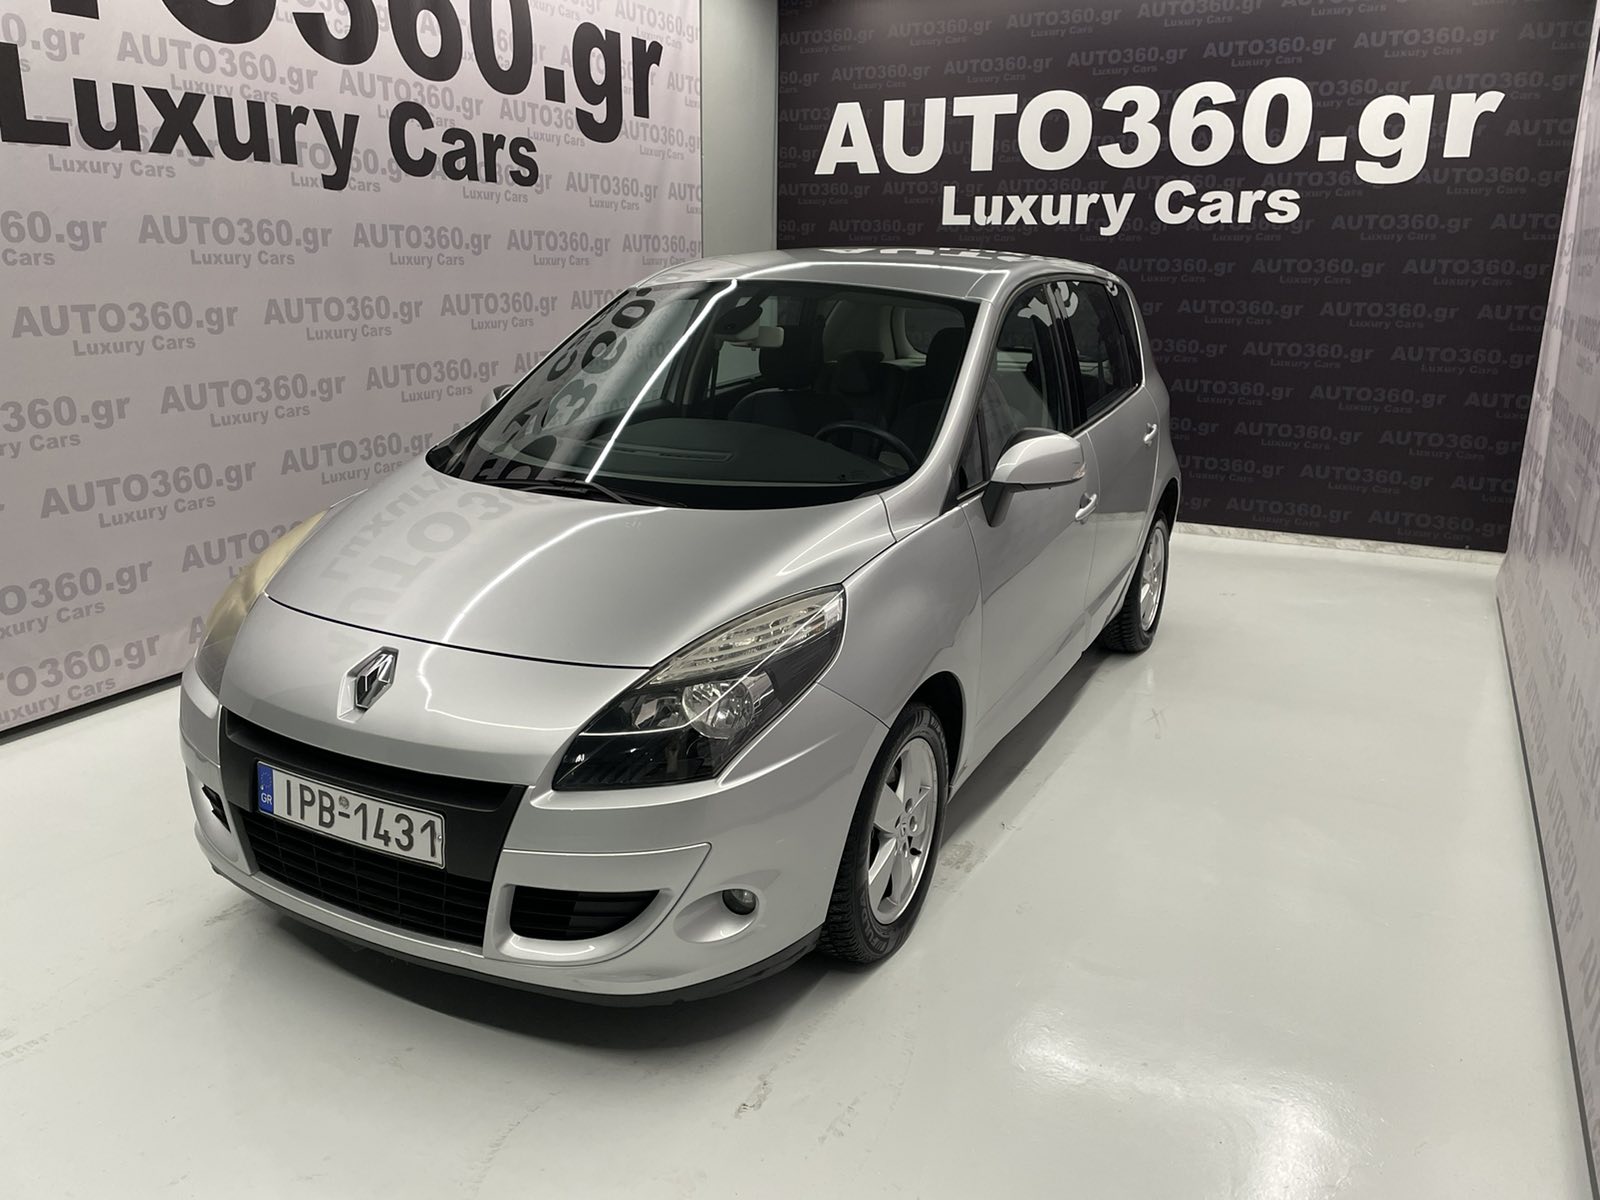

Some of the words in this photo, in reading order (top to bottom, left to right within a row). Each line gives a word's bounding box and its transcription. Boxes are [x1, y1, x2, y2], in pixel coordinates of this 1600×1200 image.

[886, 18, 993, 39] AUTO360.gr
[1005, 7, 1122, 29] AUTO360.gr
[1202, 36, 1337, 58] AUTO360.gr
[1352, 25, 1501, 49] AUTO360.gr
[116, 31, 320, 98] AUTO360.gr
[943, 55, 1053, 75] AUTO360.gr
[1066, 46, 1188, 67] AUTO360.gr
[50, 0, 663, 143] 60.gr
[830, 63, 931, 82] AUTO360.gr
[1427, 70, 1584, 93] AUTO360.gr
[171, 75, 236, 104] Luxury
[241, 86, 281, 107] Cars
[339, 69, 485, 121] AUTO360.gr
[0, 41, 360, 190] Luxury
[388, 101, 539, 187] Cars
[526, 127, 561, 147] Luxury
[563, 132, 586, 147] Cars
[814, 77, 1506, 185] AUTO360.gr
[638, 143, 666, 161] Luxury
[667, 148, 685, 161] Cars
[48, 151, 122, 179] Luxury
[129, 158, 176, 178] Cars
[1414, 166, 1567, 186] AUTO360.gr
[462, 186, 501, 205] Luxury
[504, 189, 529, 203] Cars
[565, 171, 659, 204] AUTO360.gr
[589, 196, 619, 212] Luxury
[621, 199, 640, 211] Cars
[942, 185, 1136, 237] Luxury
[1154, 179, 1301, 225] Cars
[138, 214, 332, 254] AUTO360.gr
[1330, 213, 1473, 234] AUTO360.gr
[352, 223, 492, 256] AUTO360.gr
[506, 229, 611, 257] AUTO360.gr
[0, 246, 56, 265] Cars
[190, 249, 252, 269] Luxury
[257, 250, 296, 265] Cars
[389, 252, 433, 269] Luxury
[437, 252, 465, 266] Cars
[533, 254, 566, 269] Luxury
[568, 254, 590, 266] Cars
[641, 255, 668, 268] Luxury
[1115, 257, 1236, 277] AUTO360.gr
[1251, 258, 1385, 278] AUTO360.gr
[1401, 258, 1551, 279] AUTO360.gr
[264, 295, 423, 325] AUTO360.gr
[440, 291, 558, 317] AUTO360.gr
[1177, 298, 1303, 319] AUTO360.gr
[1319, 301, 1459, 323] AUTO360.gr
[11, 301, 239, 338] AUTO360.gr
[470, 318, 508, 332] Luxury
[511, 316, 535, 328] Cars
[306, 327, 357, 342] Luxury
[361, 324, 392, 338] Cars
[73, 339, 146, 357] Luxury
[152, 335, 197, 351] Cars
[1242, 341, 1374, 363] AUTO360.gr
[1390, 345, 1536, 369] AUTO360.gr
[365, 357, 500, 391] AUTO360.gr
[161, 373, 345, 414] AUTO360.gr
[400, 389, 443, 403] Luxury
[446, 384, 473, 397] Cars
[1309, 384, 1446, 409] AUTO360.gr
[210, 410, 269, 428] Luxury
[274, 405, 310, 419] Cars
[28, 433, 81, 451] Cars
[1233, 420, 1362, 445] AUTO360.gr
[281, 432, 433, 475] AUTO360.gr
[321, 466, 369, 485] Luxury
[373, 460, 404, 475] Cars
[40, 461, 256, 519] AUTO360.gr
[99, 505, 167, 528] Luxury
[173, 496, 216, 513] Cars
[57, 600, 107, 622] Cars
[66, 677, 115, 701] Cars
[260, 792, 273, 806] GR
[286, 779, 437, 859] IPB-1431
